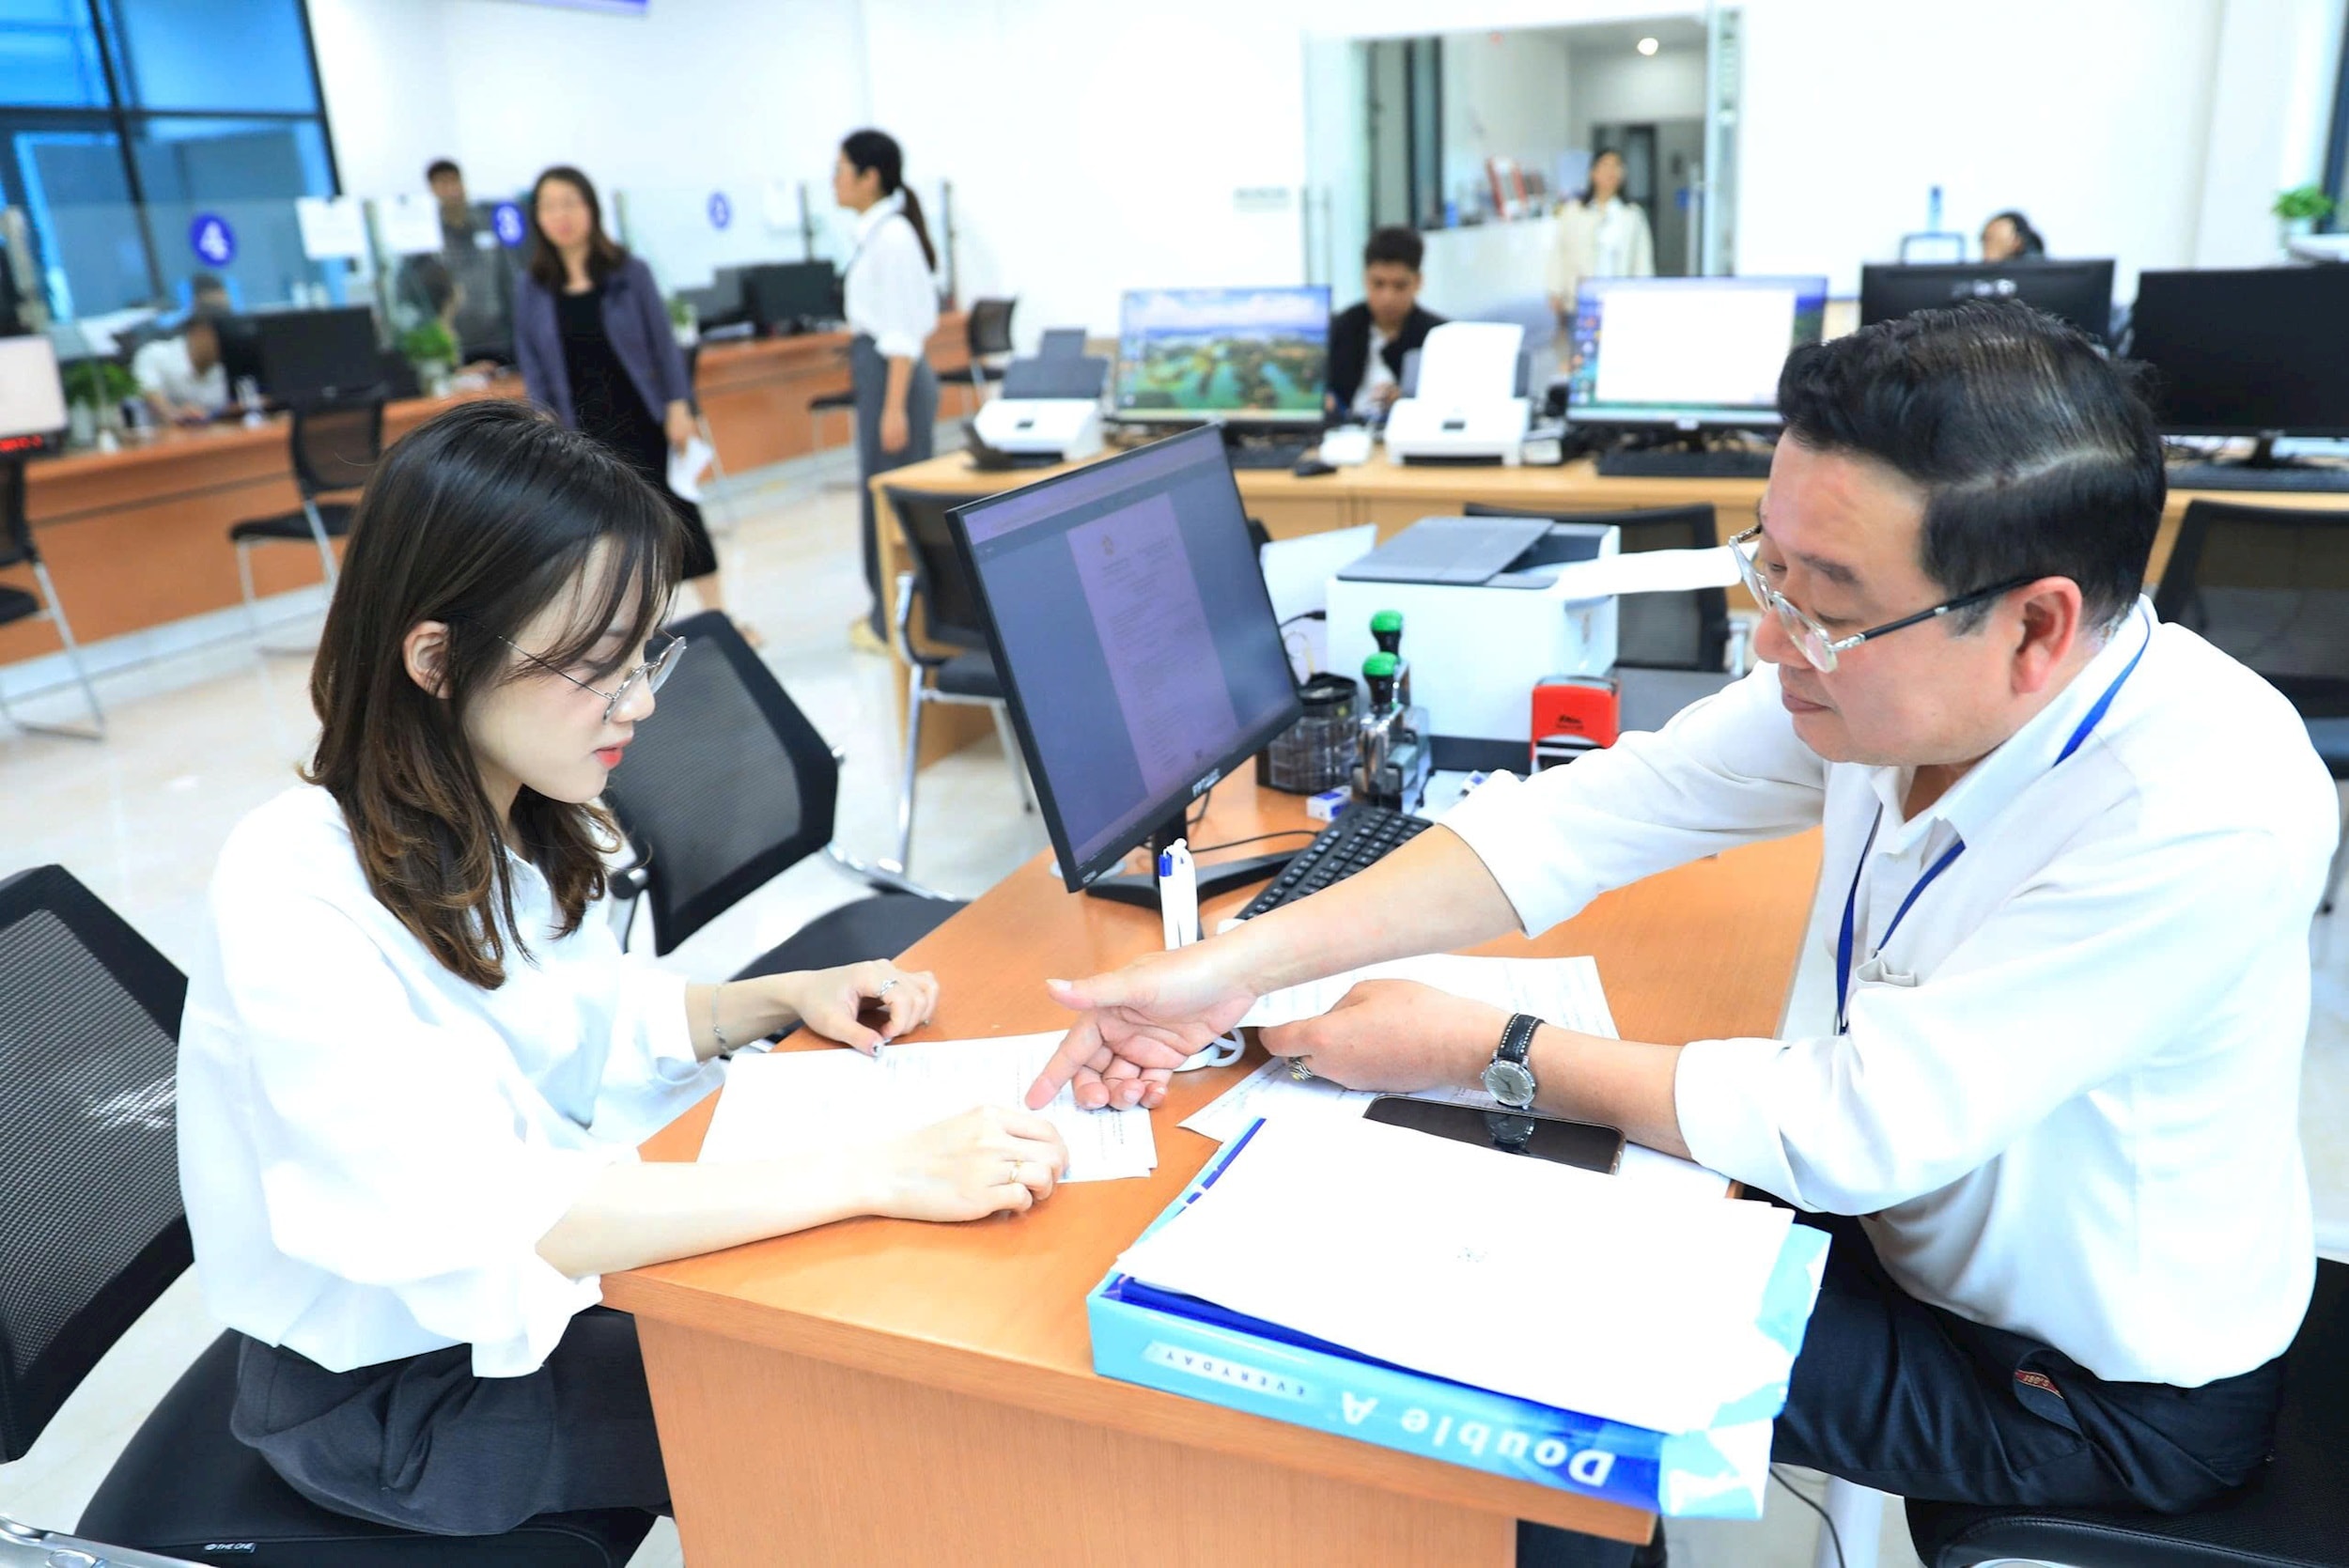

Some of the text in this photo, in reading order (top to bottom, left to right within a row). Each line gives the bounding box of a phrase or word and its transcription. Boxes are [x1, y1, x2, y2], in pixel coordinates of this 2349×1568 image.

[199, 221, 229, 260] 4
[1166, 1351, 1305, 1396] EVERYDAY
[1341, 1390, 1616, 1488] Double A
